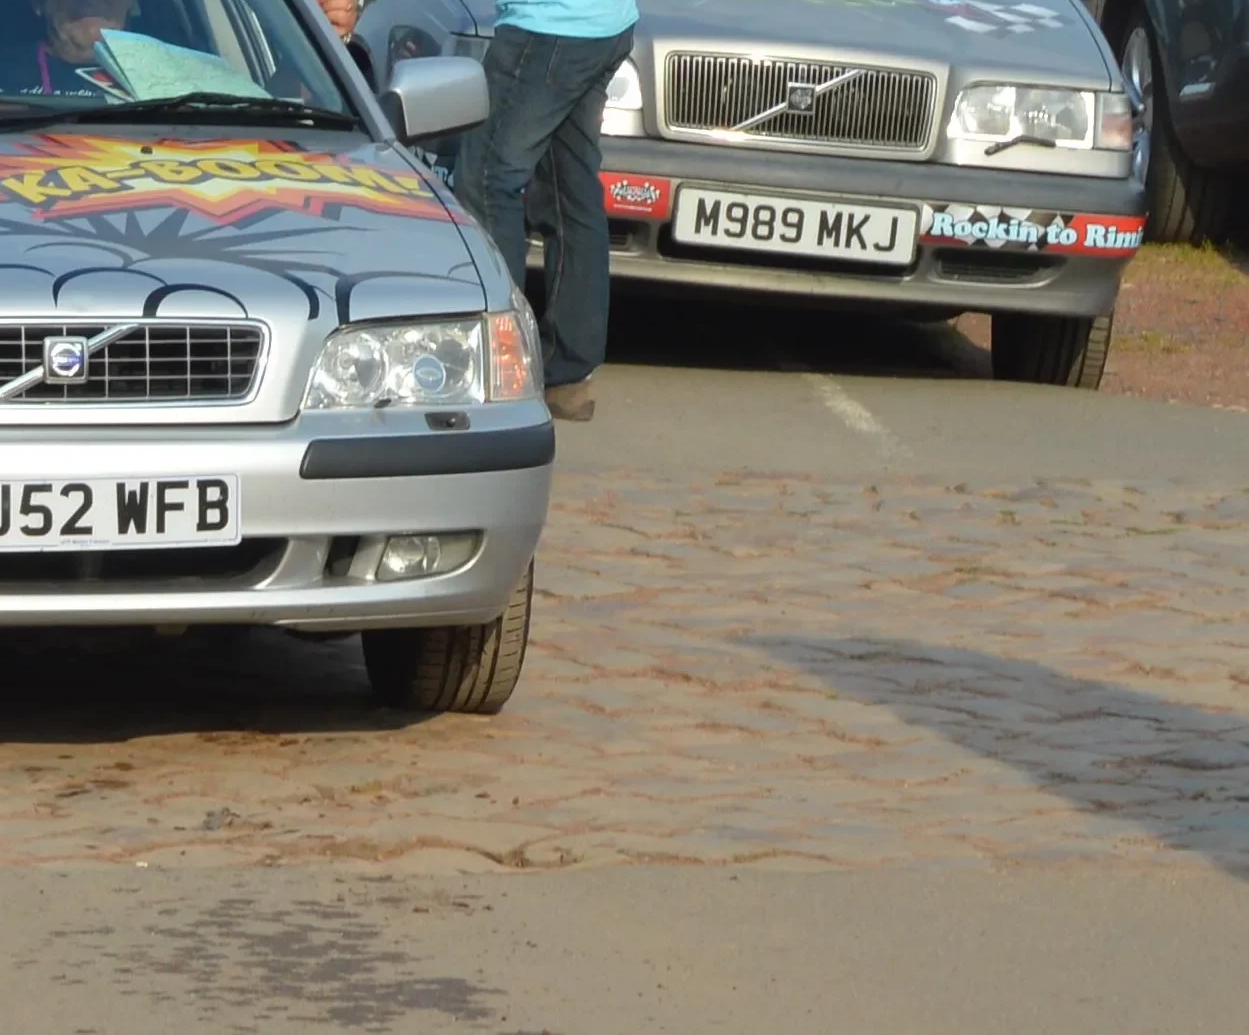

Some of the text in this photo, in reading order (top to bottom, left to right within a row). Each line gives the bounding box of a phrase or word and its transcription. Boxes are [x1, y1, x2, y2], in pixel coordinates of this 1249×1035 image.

[0, 158, 435, 204] KA-BOOM!
[693, 197, 899, 253] M989 MKJ
[930, 212, 1038, 243] Rockin
[1046, 224, 1077, 246] to
[115, 479, 229, 534] WFB
